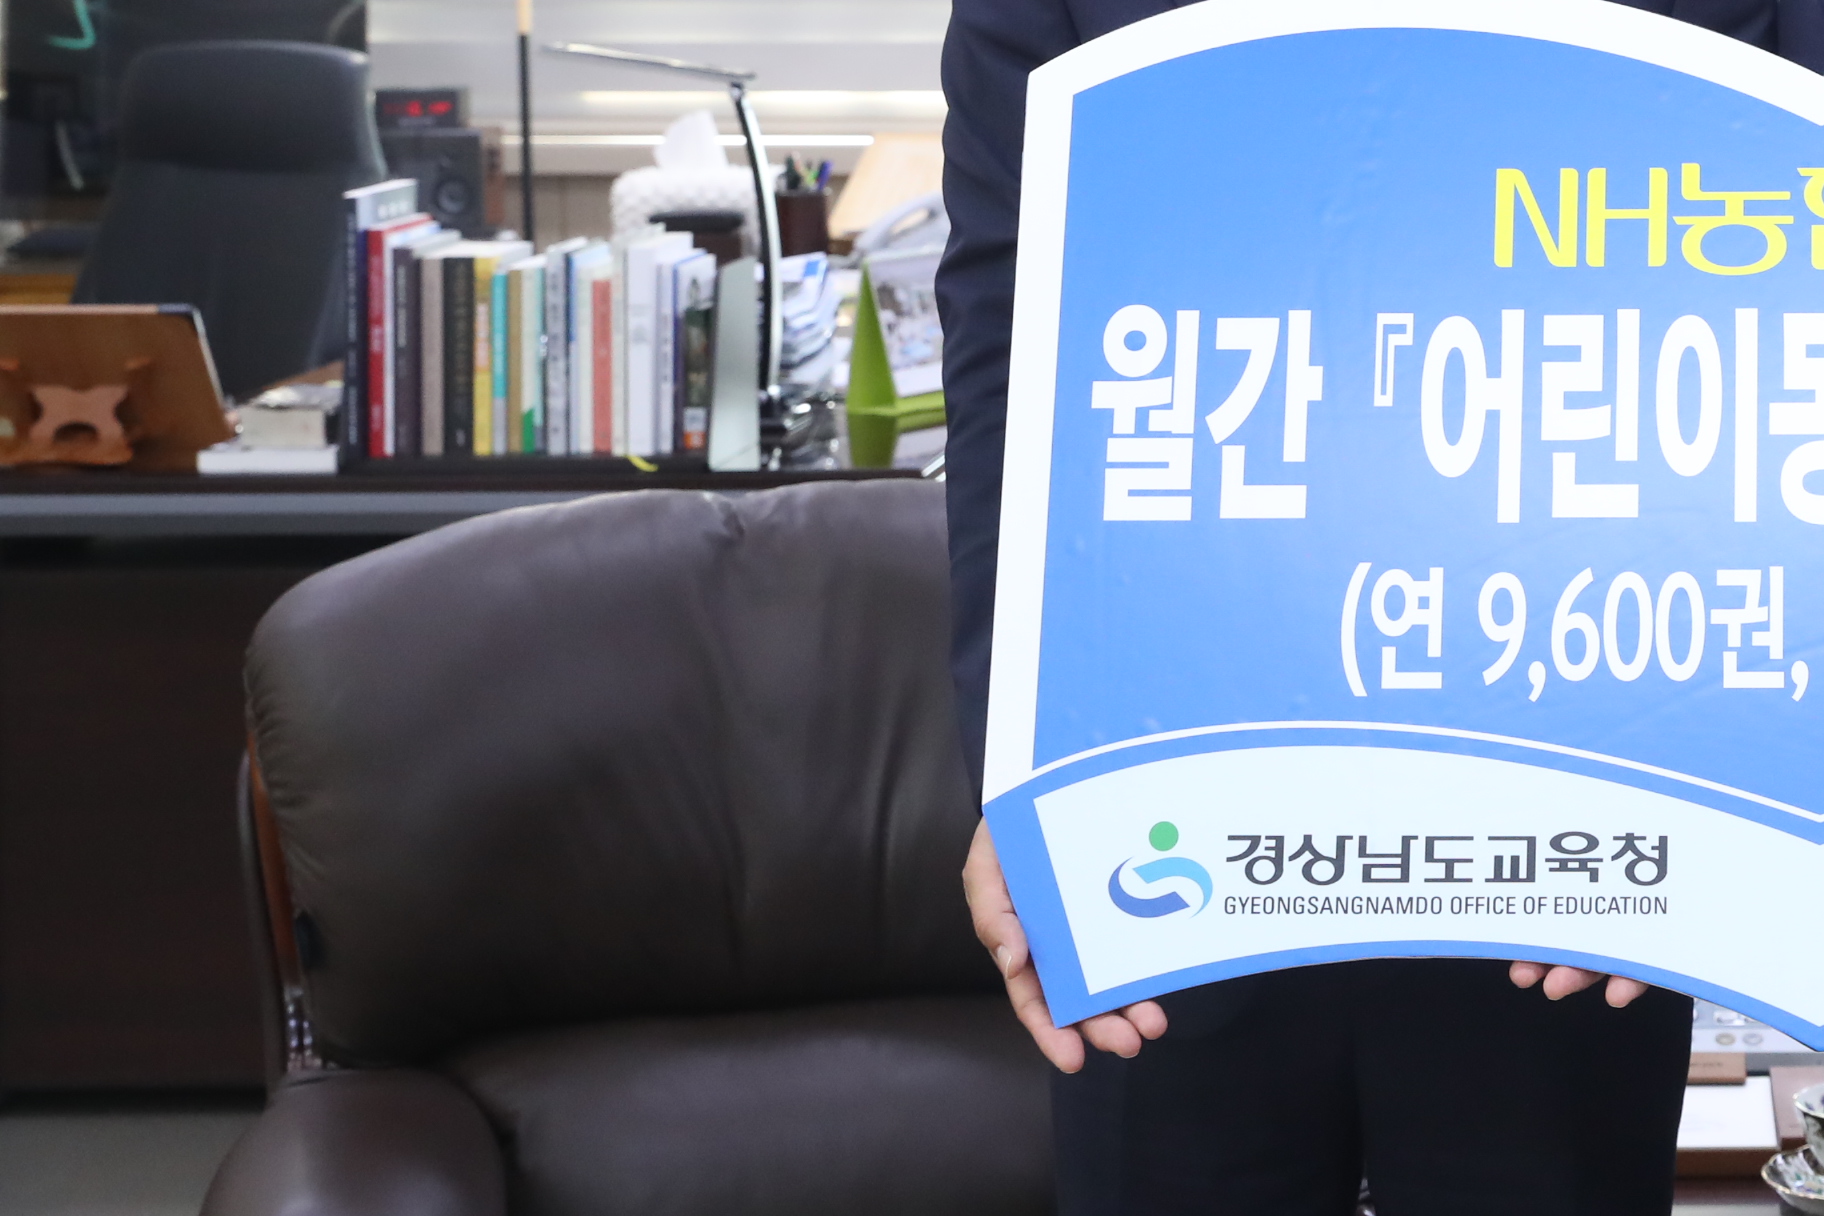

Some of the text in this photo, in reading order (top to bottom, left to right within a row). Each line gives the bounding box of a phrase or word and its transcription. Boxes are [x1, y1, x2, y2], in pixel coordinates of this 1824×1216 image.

[1090, 303, 1323, 522] 월간
[1341, 562, 1444, 697] (연
[1477, 565, 1809, 703] 9,600권,
[1223, 895, 1668, 916] GYEONGSANGNAMDO OFFICE OF EDUCATION
[1225, 830, 1669, 887] 경상남도교육청
